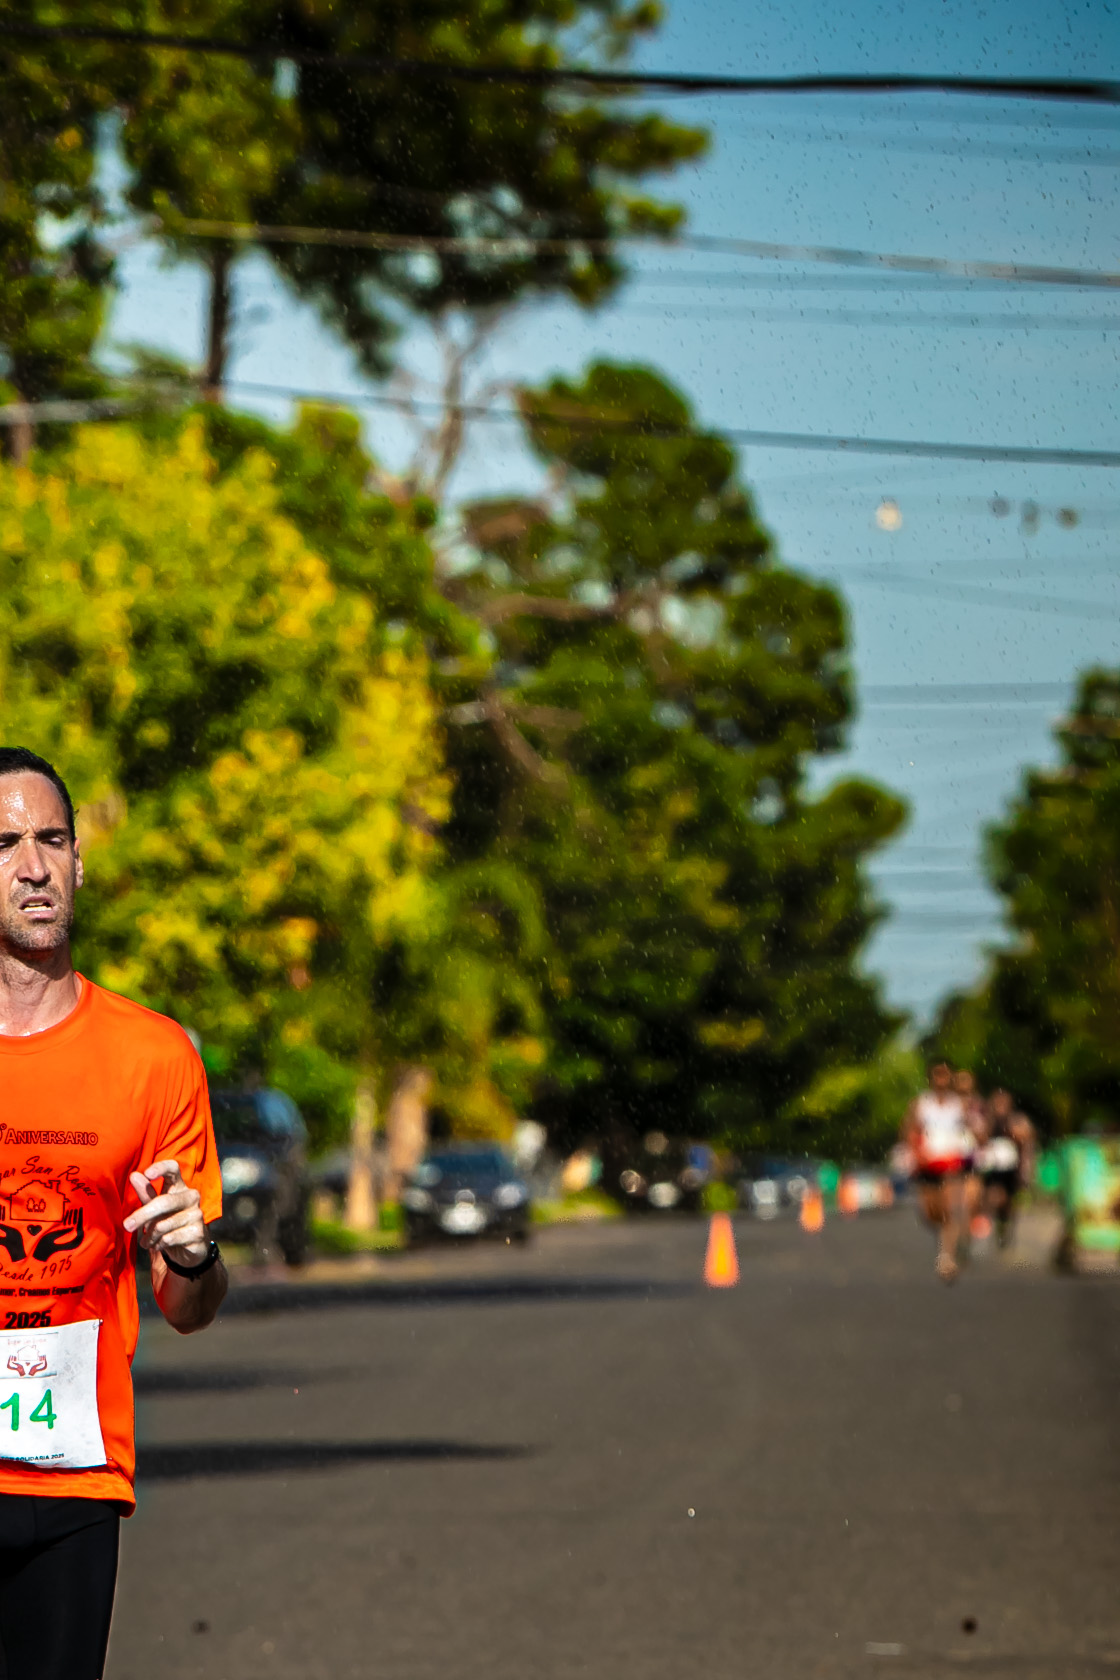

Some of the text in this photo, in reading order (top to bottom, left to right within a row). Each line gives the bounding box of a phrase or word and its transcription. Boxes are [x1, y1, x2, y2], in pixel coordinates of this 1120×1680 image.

[21, 1156, 53, 1175] San
[57, 1166, 96, 1196] Roque
[41, 1255, 72, 1279] 1975
[5, 1310, 51, 1329] 2025
[0, 1388, 57, 1431] 14
